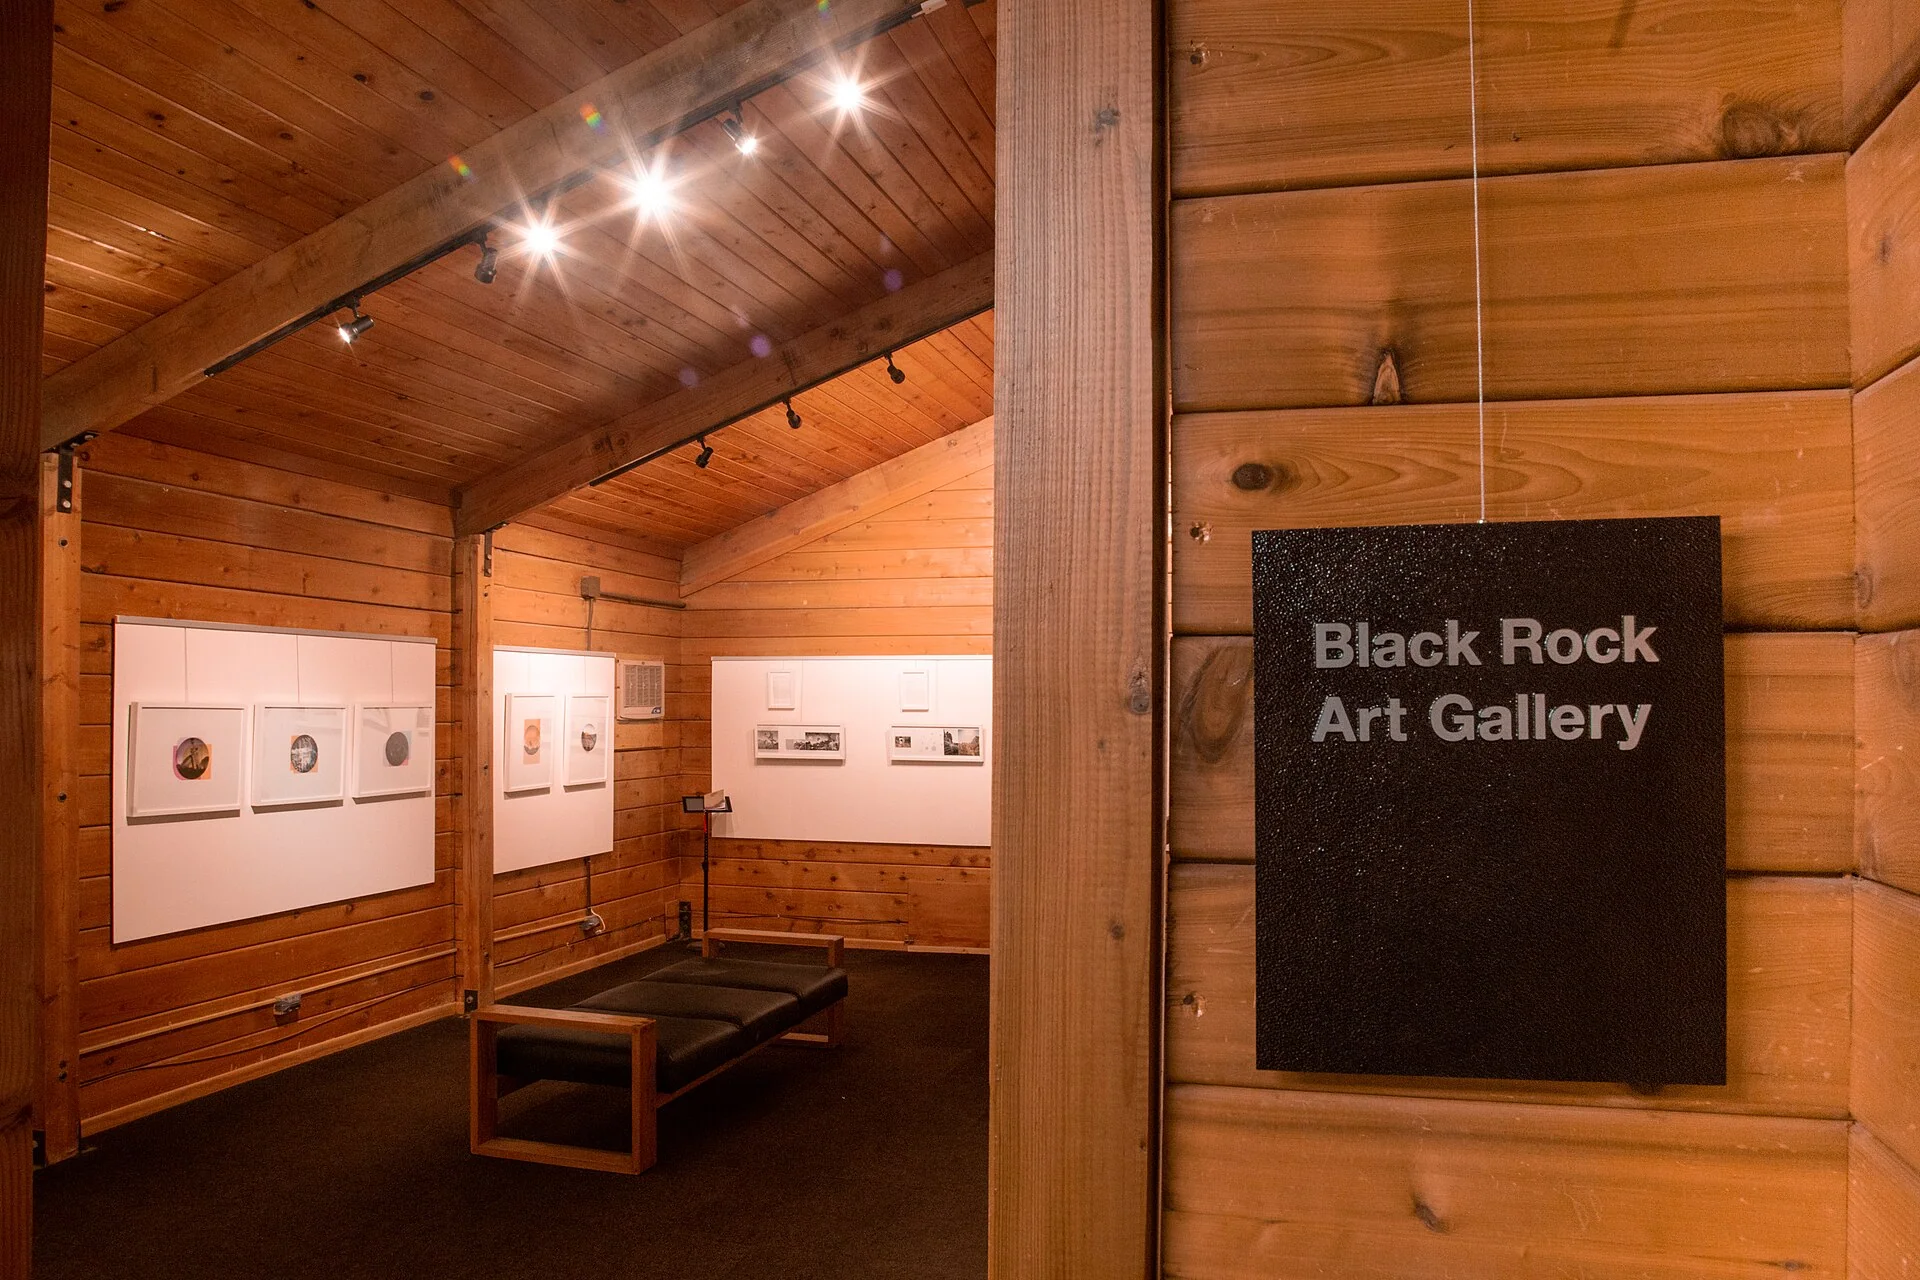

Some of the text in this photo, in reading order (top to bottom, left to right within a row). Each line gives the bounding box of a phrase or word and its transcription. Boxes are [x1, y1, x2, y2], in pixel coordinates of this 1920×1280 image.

[1315, 615, 1660, 669] Black Rock
[1311, 693, 1653, 751] Art Gallery
